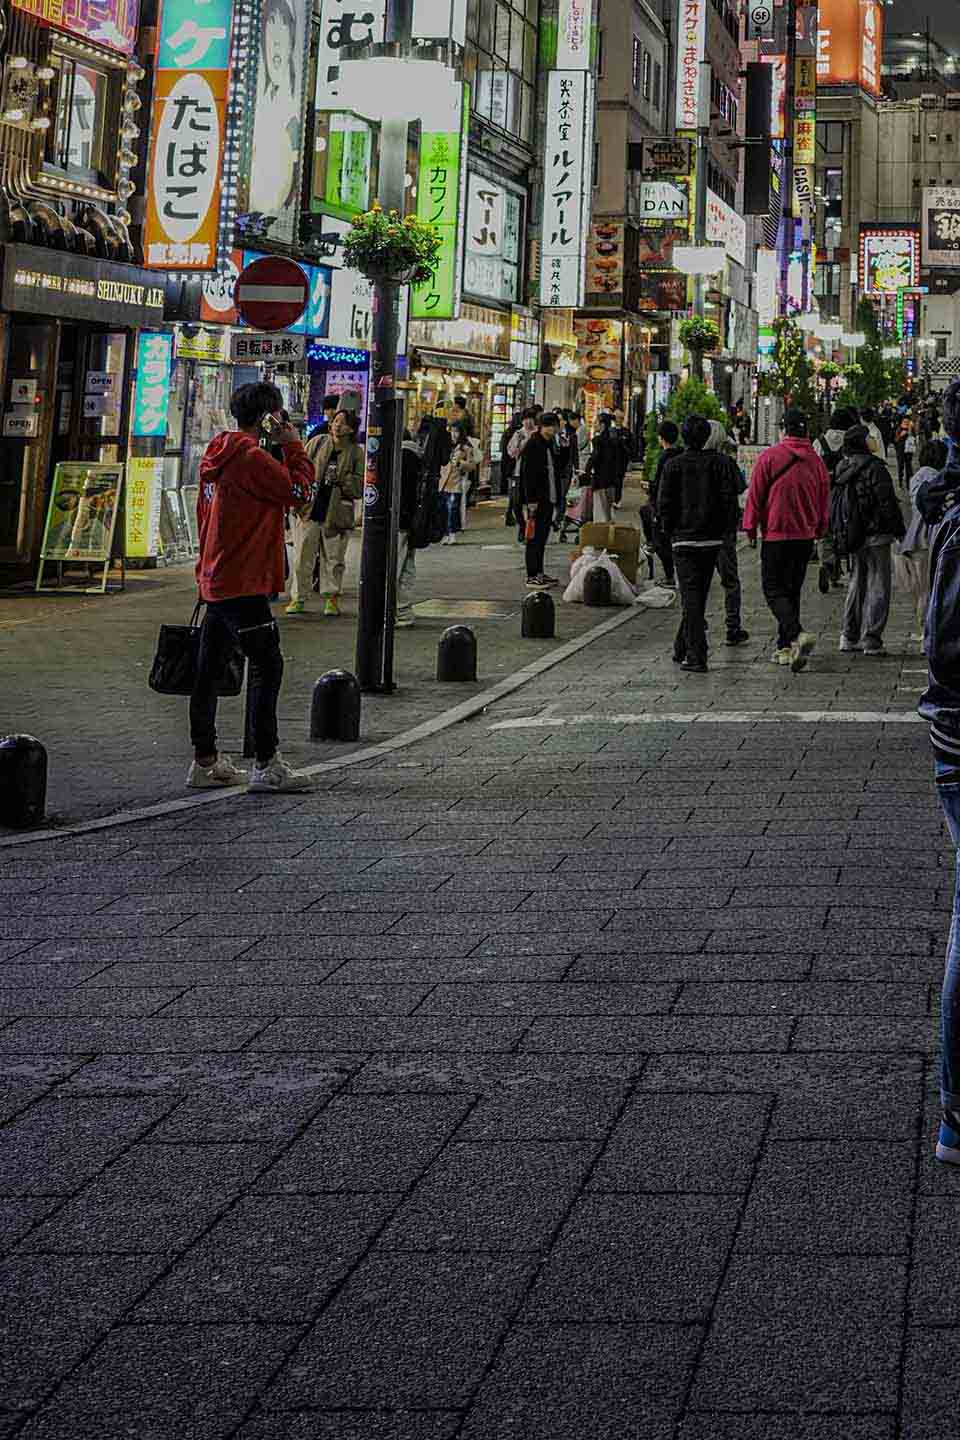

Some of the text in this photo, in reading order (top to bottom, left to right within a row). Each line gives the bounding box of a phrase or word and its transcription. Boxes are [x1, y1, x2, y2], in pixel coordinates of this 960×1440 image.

[163, 96, 210, 220] たばこ
[97, 279, 144, 305] SHINJUKU
[145, 287, 164, 308] ALE
[236, 340, 298, 356] 自転車を除く
[91, 376, 112, 385] OPEN
